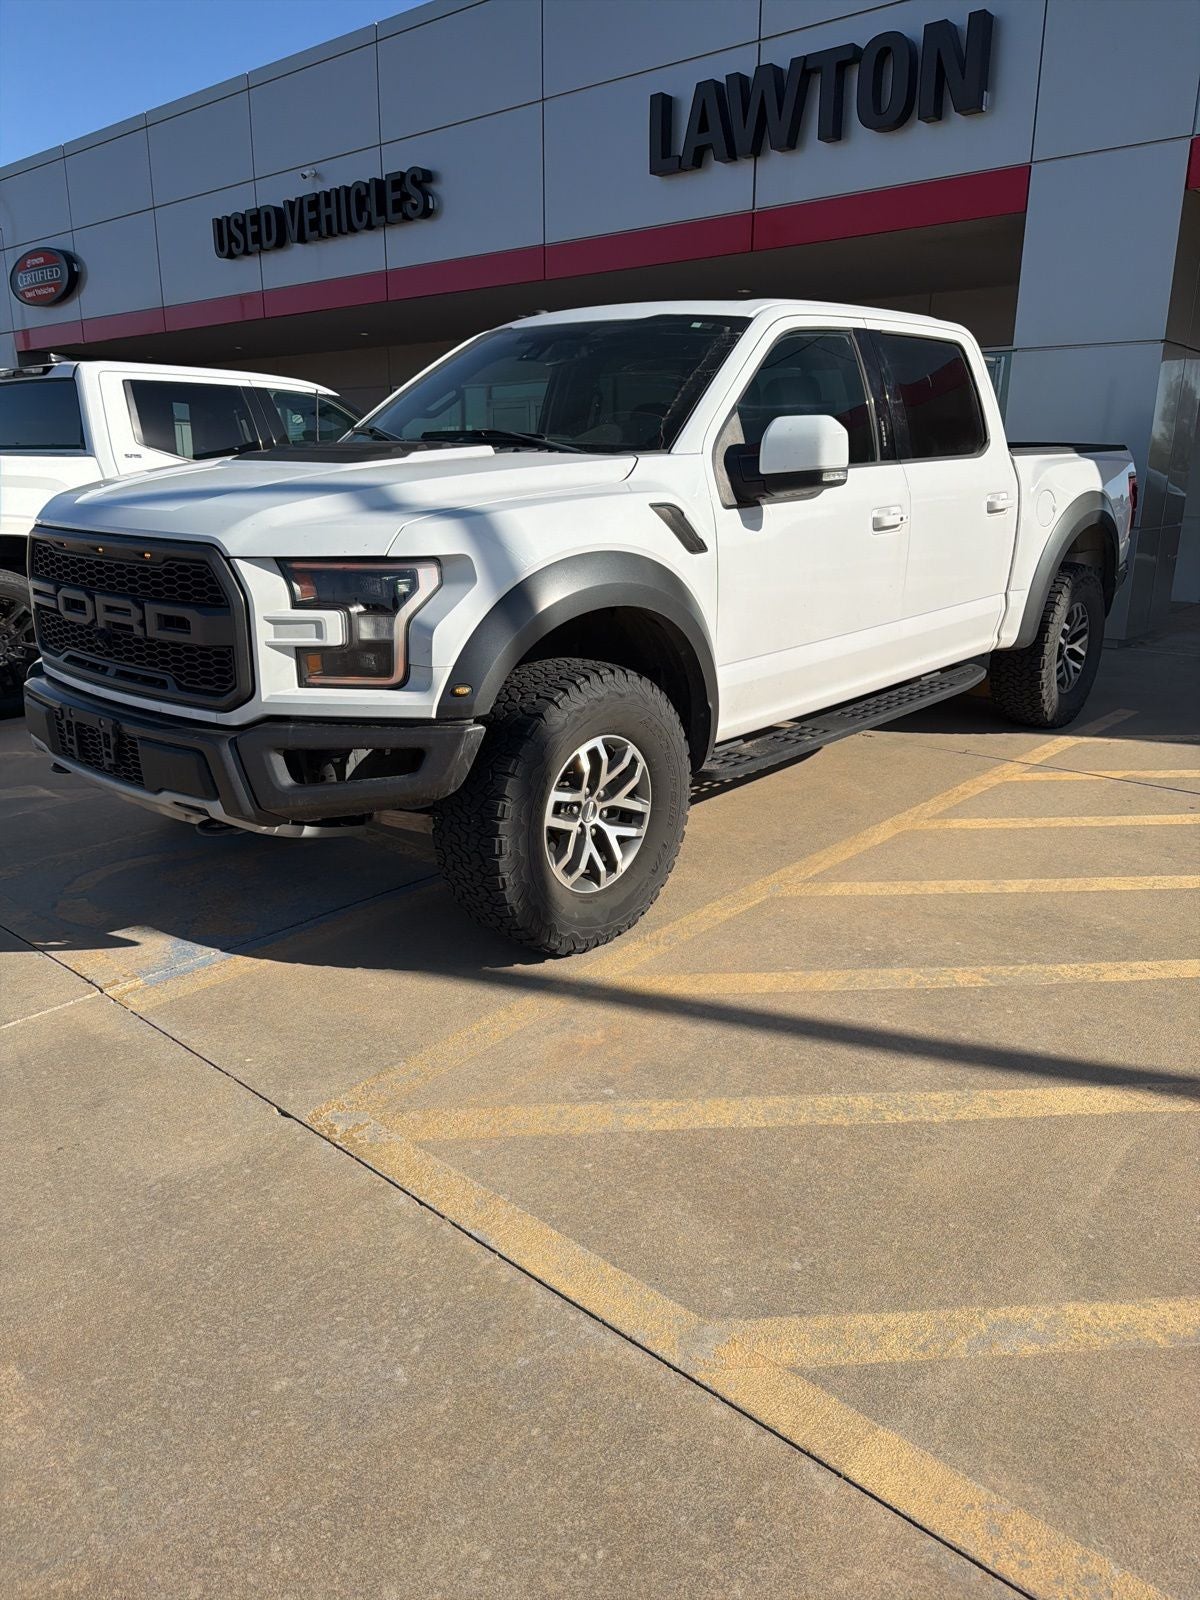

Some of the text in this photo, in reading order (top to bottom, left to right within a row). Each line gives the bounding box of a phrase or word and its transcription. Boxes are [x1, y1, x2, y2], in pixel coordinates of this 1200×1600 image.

[650, 9, 994, 177] LAWTON
[212, 166, 435, 259] USED VEHICLES
[17, 267, 61, 287] CERTIFIED
[29, 579, 203, 645] FORD
